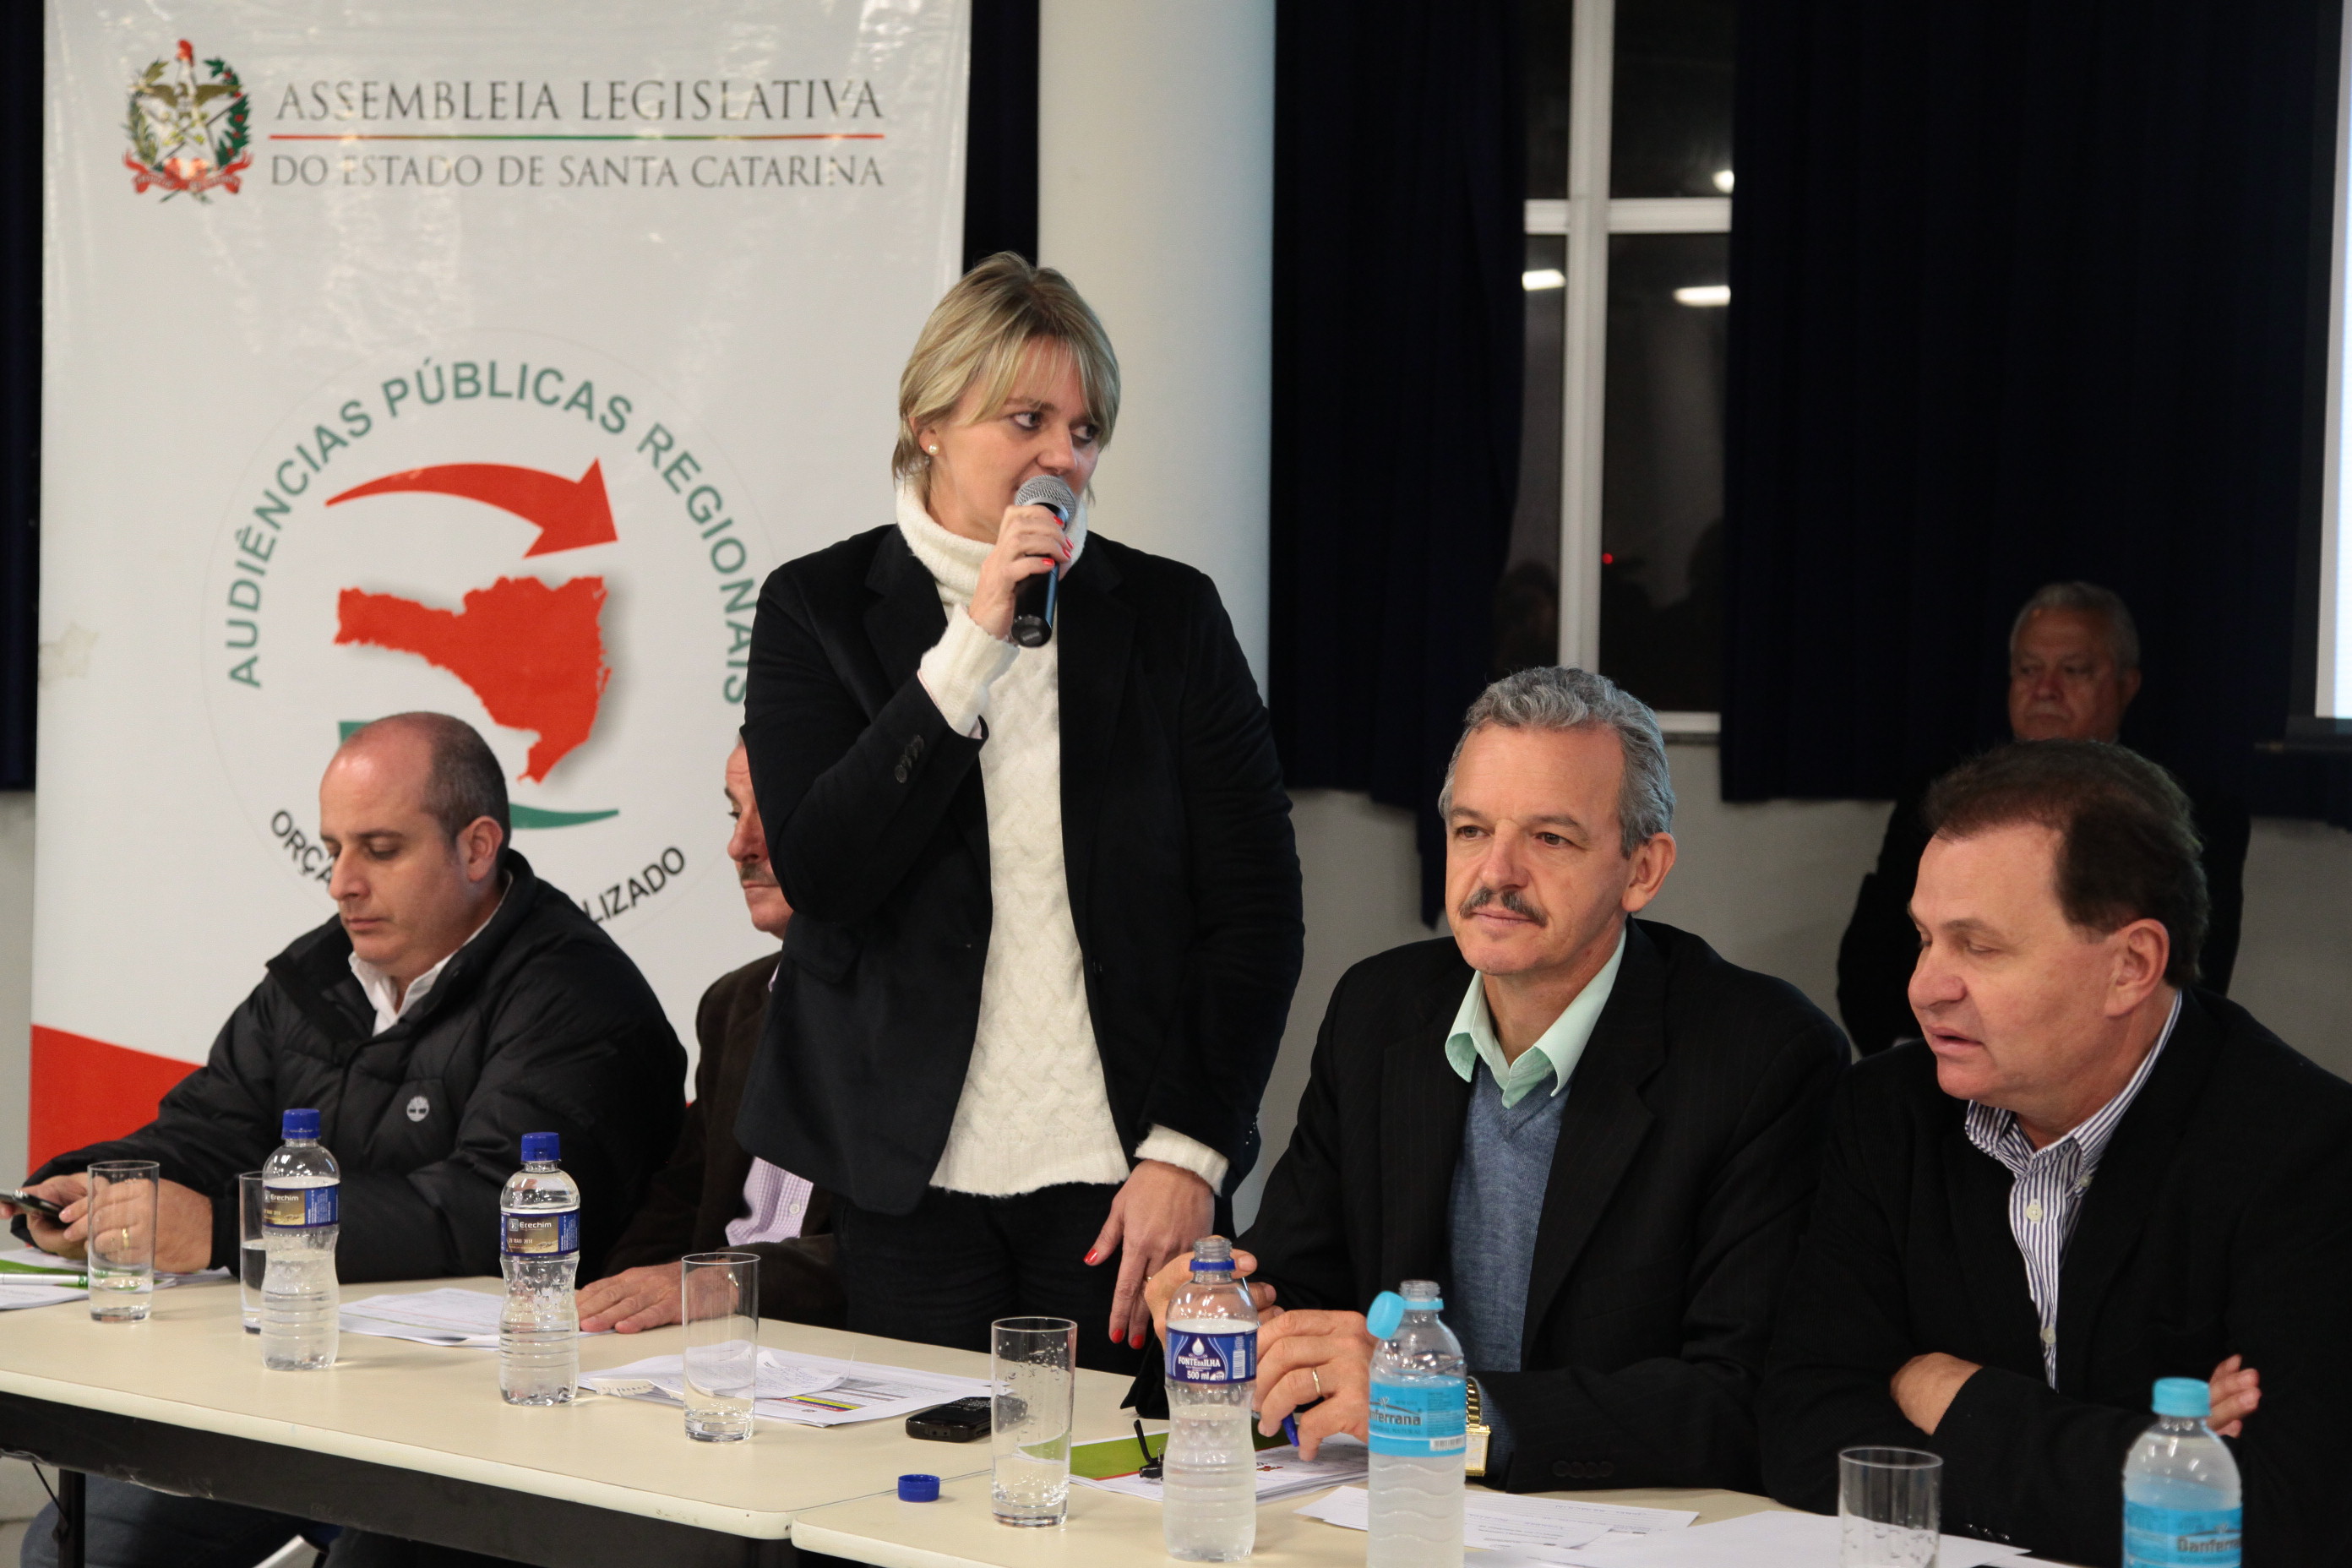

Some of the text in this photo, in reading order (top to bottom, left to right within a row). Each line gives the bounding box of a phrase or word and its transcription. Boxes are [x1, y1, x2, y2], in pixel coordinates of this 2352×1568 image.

[275, 79, 885, 122] ASSEMBLEIA LEGISLATIVA
[270, 155, 329, 188] DO
[342, 154, 485, 188] ESTADO
[498, 155, 545, 188] DE
[558, 155, 680, 188] SANTA
[690, 154, 885, 188] CATARINA
[226, 357, 757, 705] AUDIÊNCIAS PÚBLICAS REGIONAIS
[271, 810, 334, 890] ORÇA
[582, 847, 684, 923] LIZADO
[270, 1193, 299, 1201] Erechim
[1187, 1369, 1200, 1380] 500
[1200, 1371, 1210, 1380] ml
